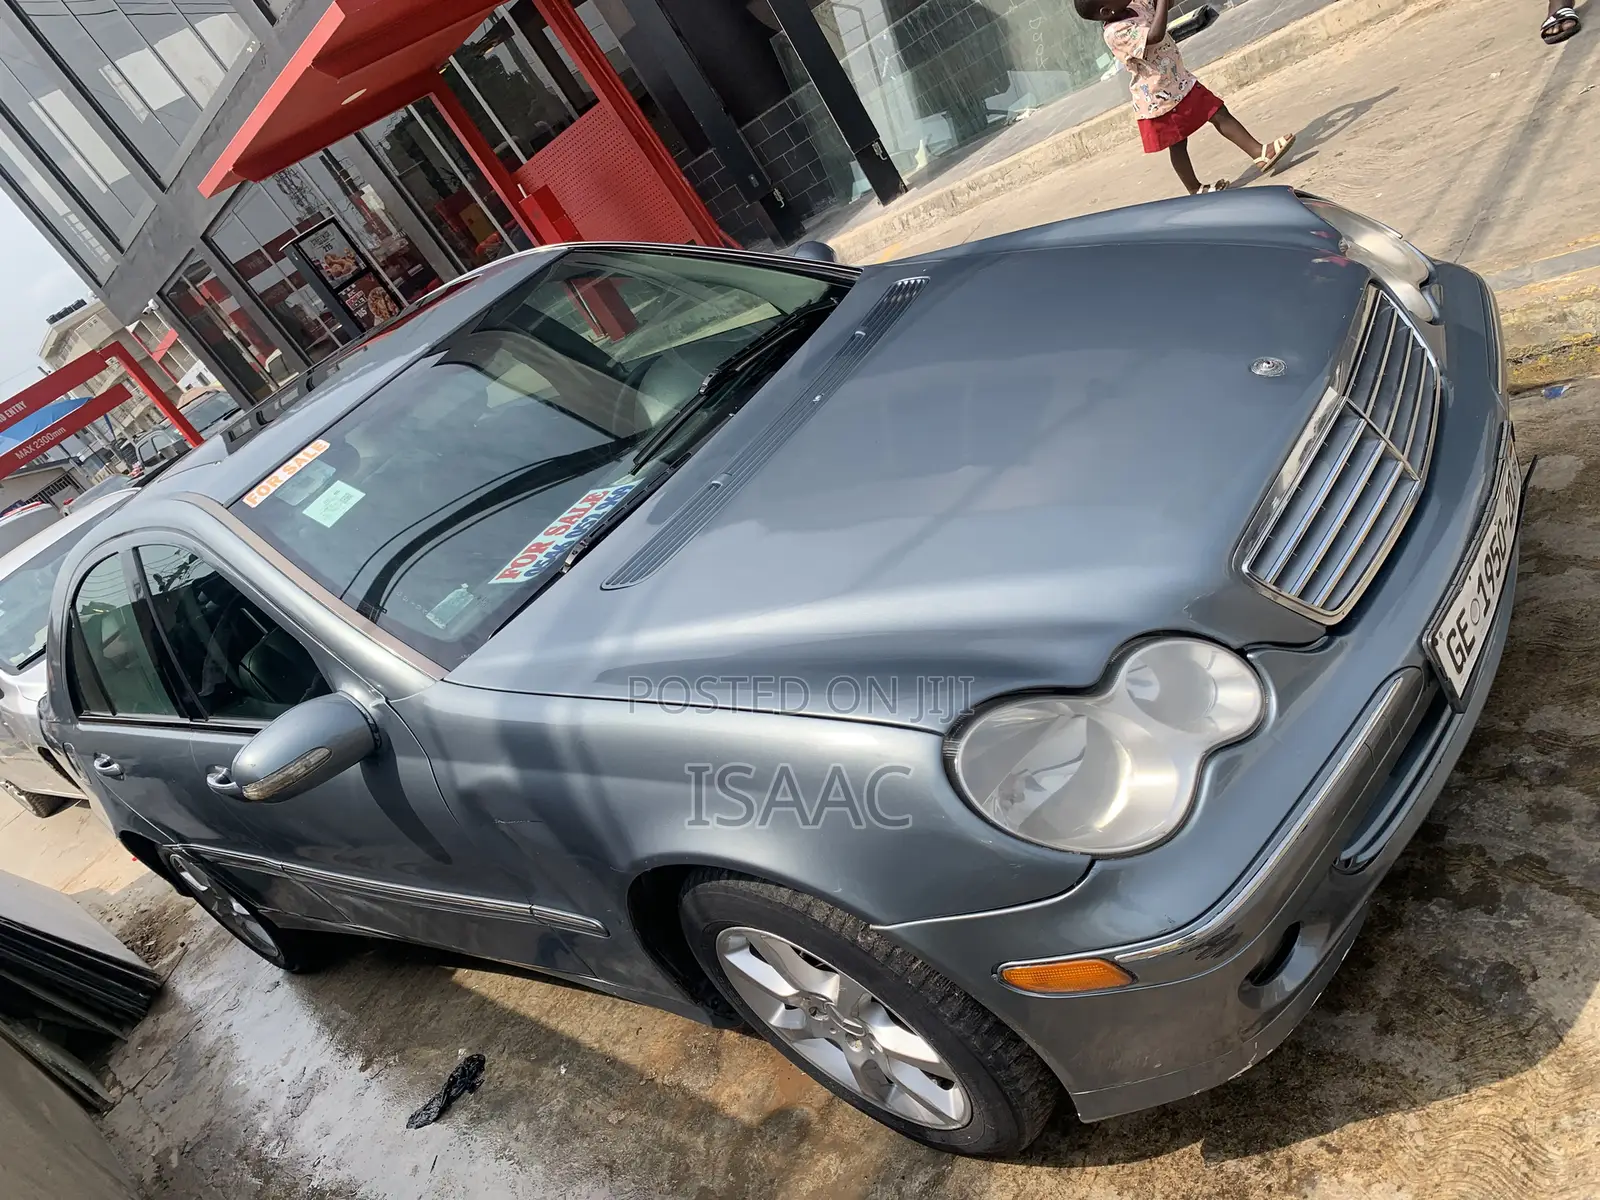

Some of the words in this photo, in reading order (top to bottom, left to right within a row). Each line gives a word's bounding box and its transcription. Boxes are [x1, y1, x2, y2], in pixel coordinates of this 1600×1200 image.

[4, 400, 27, 418] ENTRY
[14, 444, 36, 460] MAX
[33, 427, 67, 449] 2300mm
[246, 475, 283, 505] FOR
[283, 441, 327, 475] SALE
[495, 540, 556, 580] FOR
[543, 490, 610, 537] SALE
[1446, 607, 1476, 675] GE
